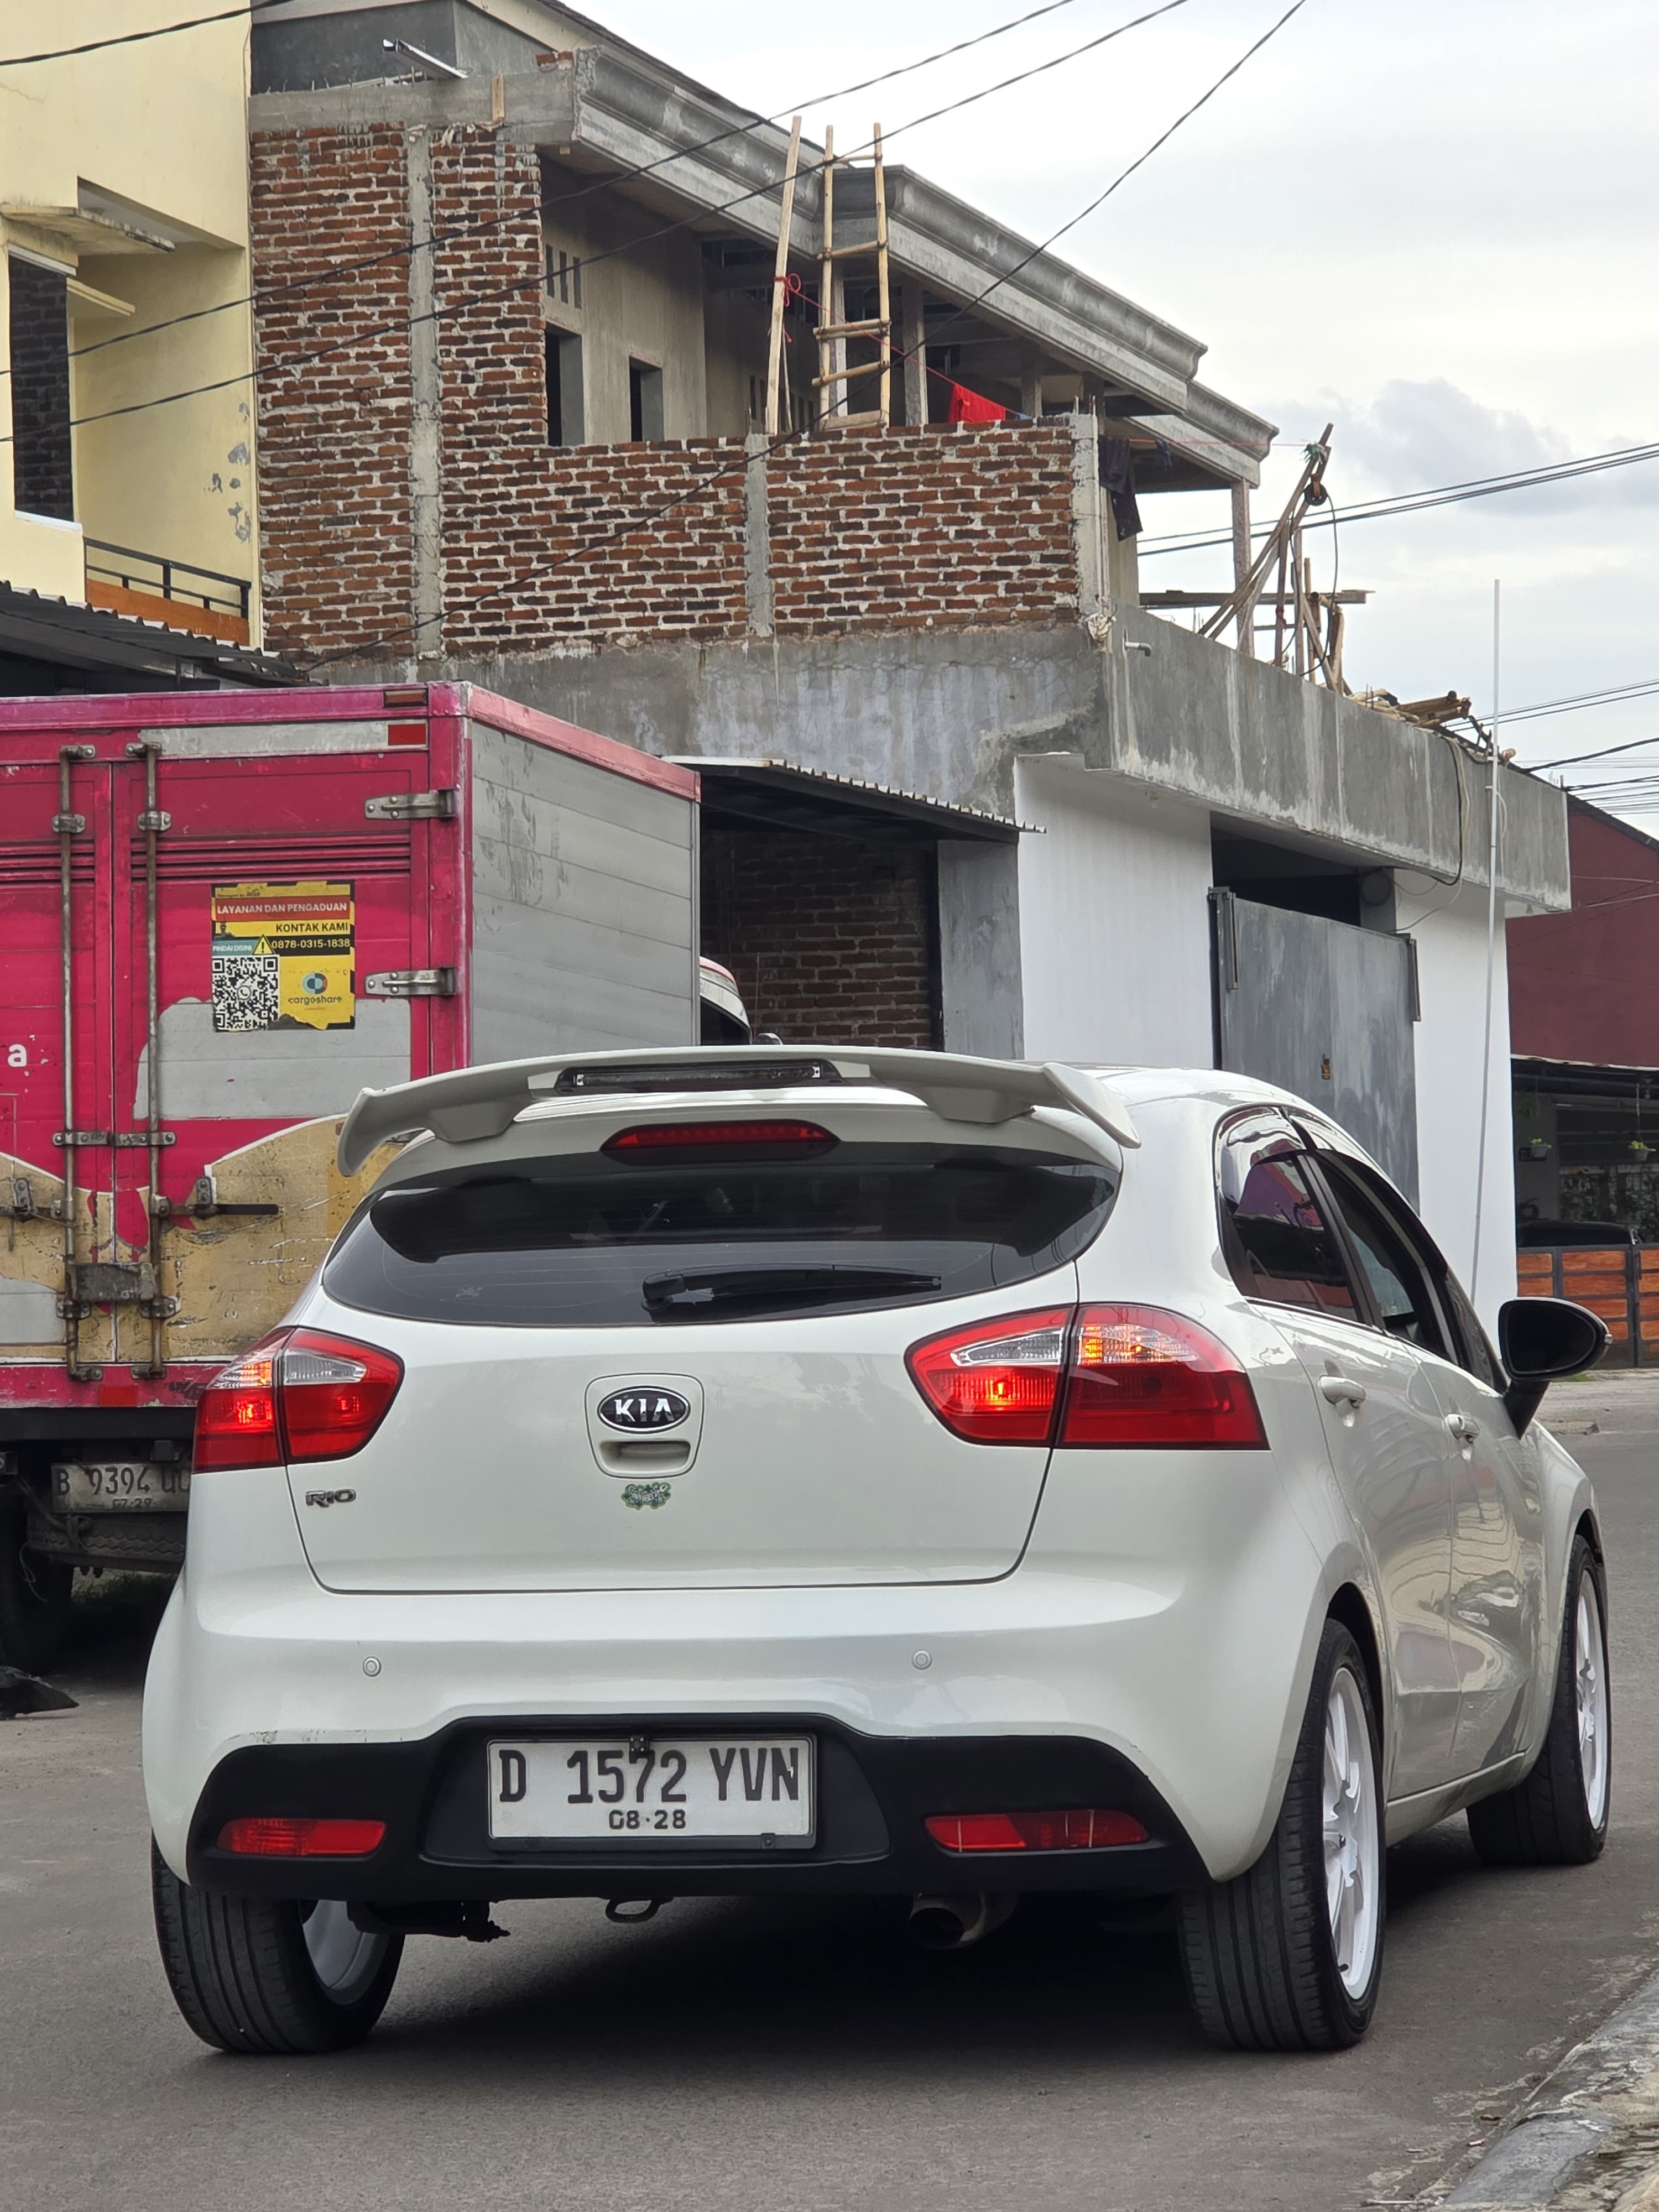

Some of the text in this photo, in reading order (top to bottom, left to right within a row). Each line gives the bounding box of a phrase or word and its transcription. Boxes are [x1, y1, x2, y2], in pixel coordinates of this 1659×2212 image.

[217, 902, 347, 914] LAYANAN DAN PENGADUAN
[276, 922, 348, 932] KONTAK KAMI
[271, 938, 350, 949] 0878-0315-1838
[288, 995, 342, 1005] cargoshare
[613, 1398, 675, 1422] KIA
[56, 1468, 71, 1495] B
[88, 1467, 150, 1495] 9394
[499, 1747, 799, 1804] D 1572 YVN
